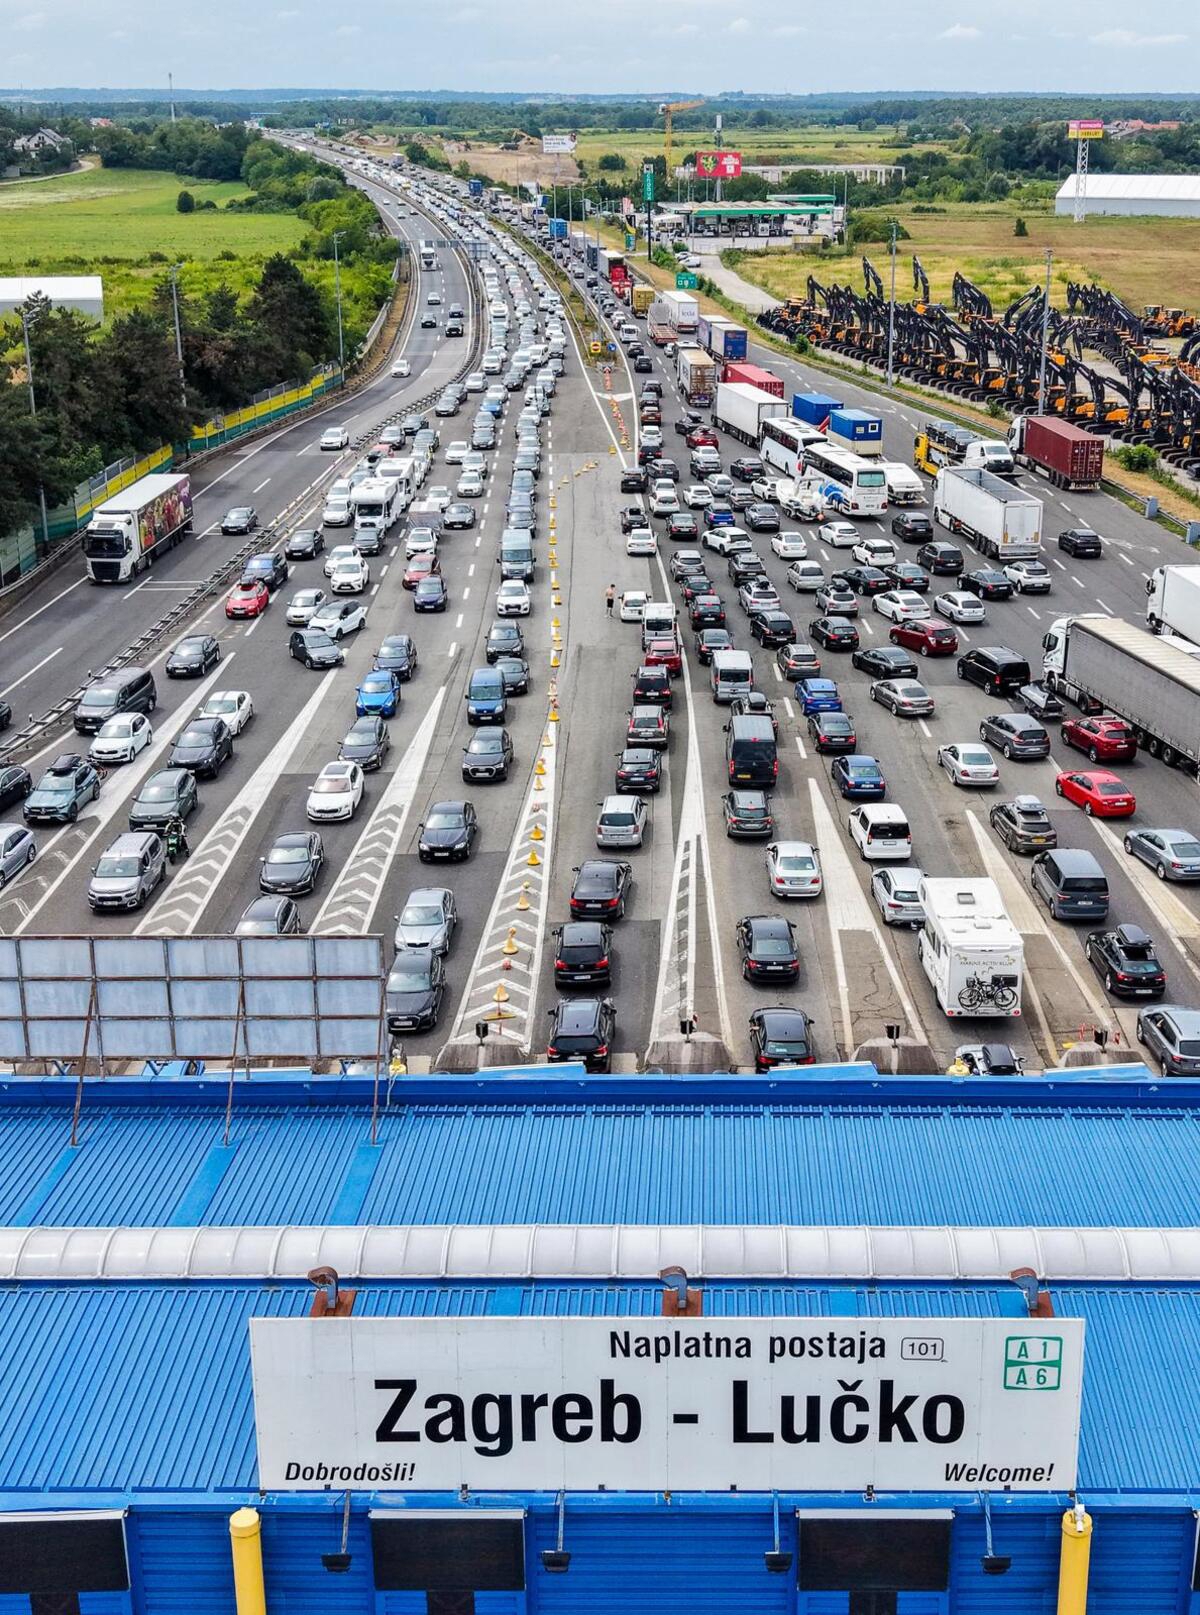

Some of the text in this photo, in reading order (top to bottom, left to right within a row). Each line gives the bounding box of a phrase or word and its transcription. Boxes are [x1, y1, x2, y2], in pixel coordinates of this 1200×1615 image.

[610, 1330, 937, 1364] Naplatna postaja 101
[1017, 1341, 1048, 1359] A 1
[1015, 1367, 1047, 1385] A 6
[374, 1378, 965, 1458] Zagreb - Lučko
[285, 1462, 1056, 1485] Dobrodošli! Welcome!
